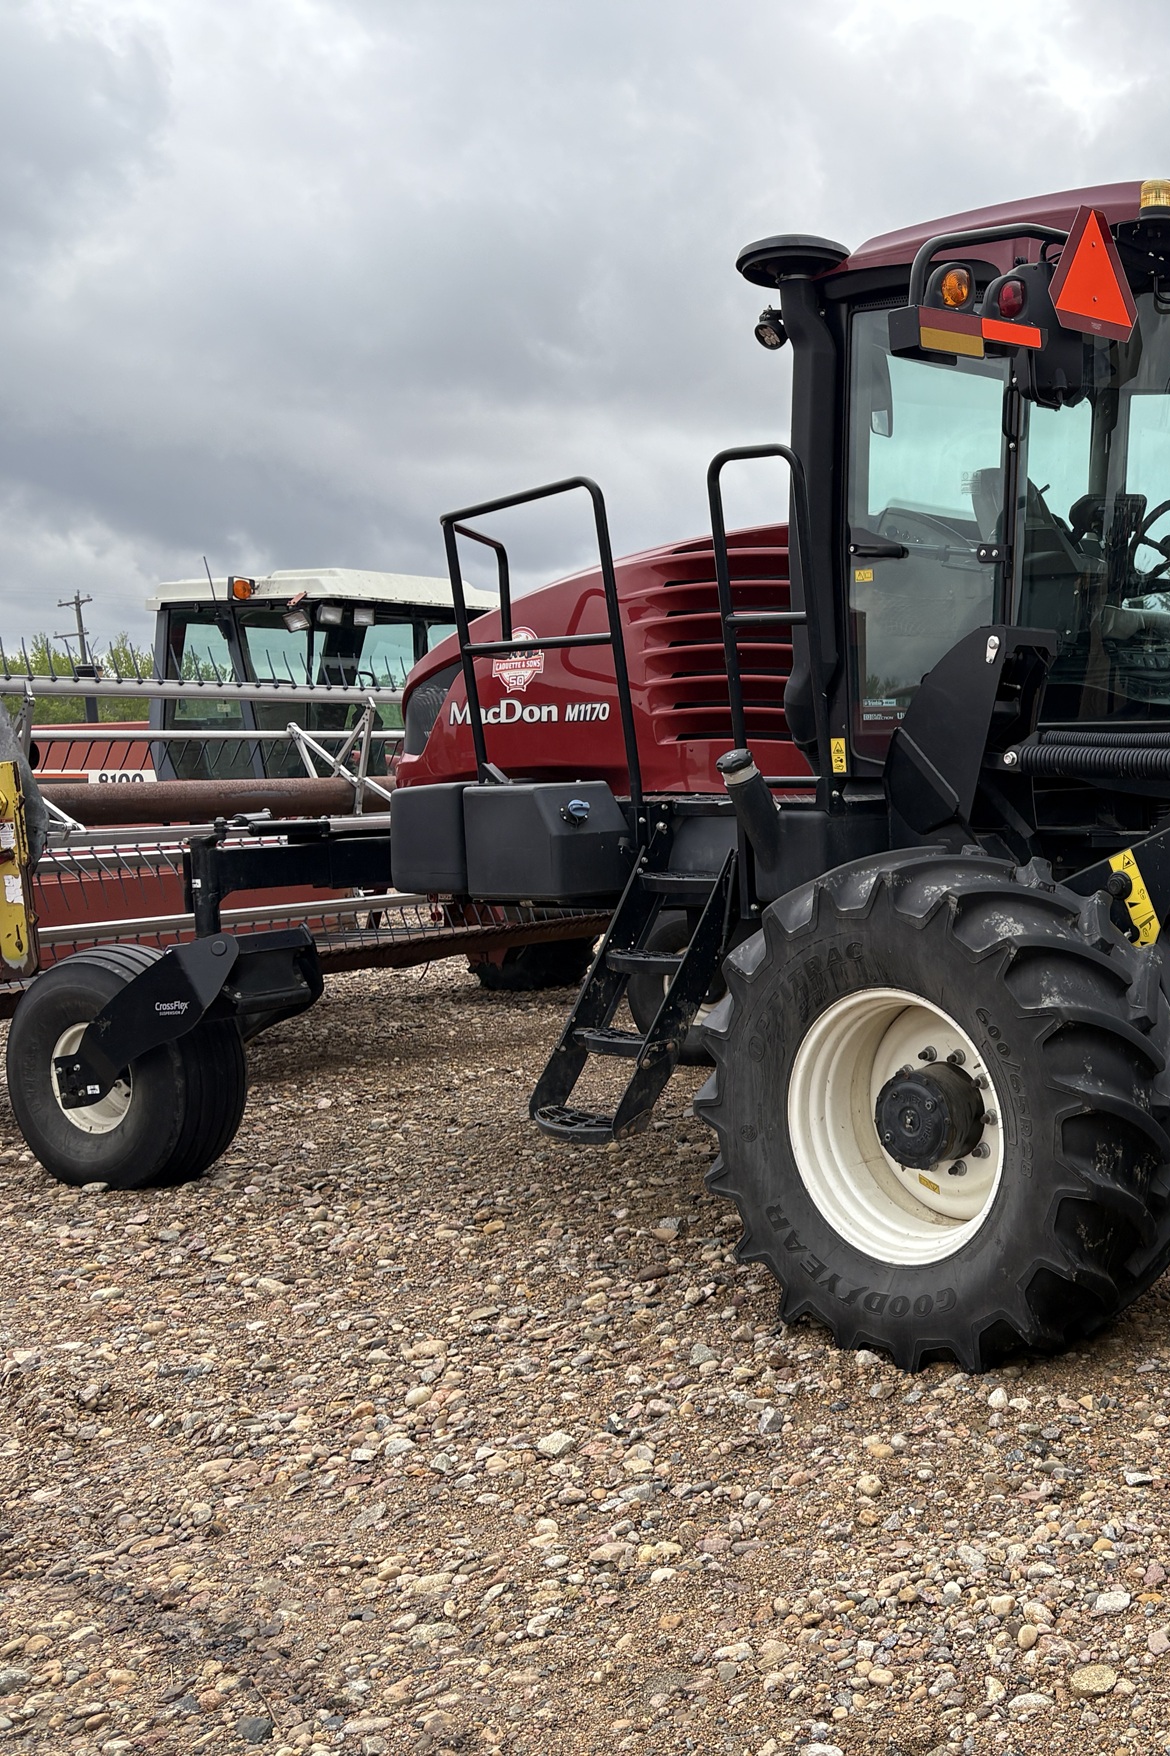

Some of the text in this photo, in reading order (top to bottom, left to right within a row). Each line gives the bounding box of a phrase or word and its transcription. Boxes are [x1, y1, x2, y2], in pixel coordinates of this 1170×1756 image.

[526, 659, 541, 668] SONS
[509, 675, 525, 687] 50
[449, 698, 610, 725] MacDon M1170
[155, 1000, 190, 1015] CrossFlex
[765, 1204, 957, 1318] GOODYEAR
